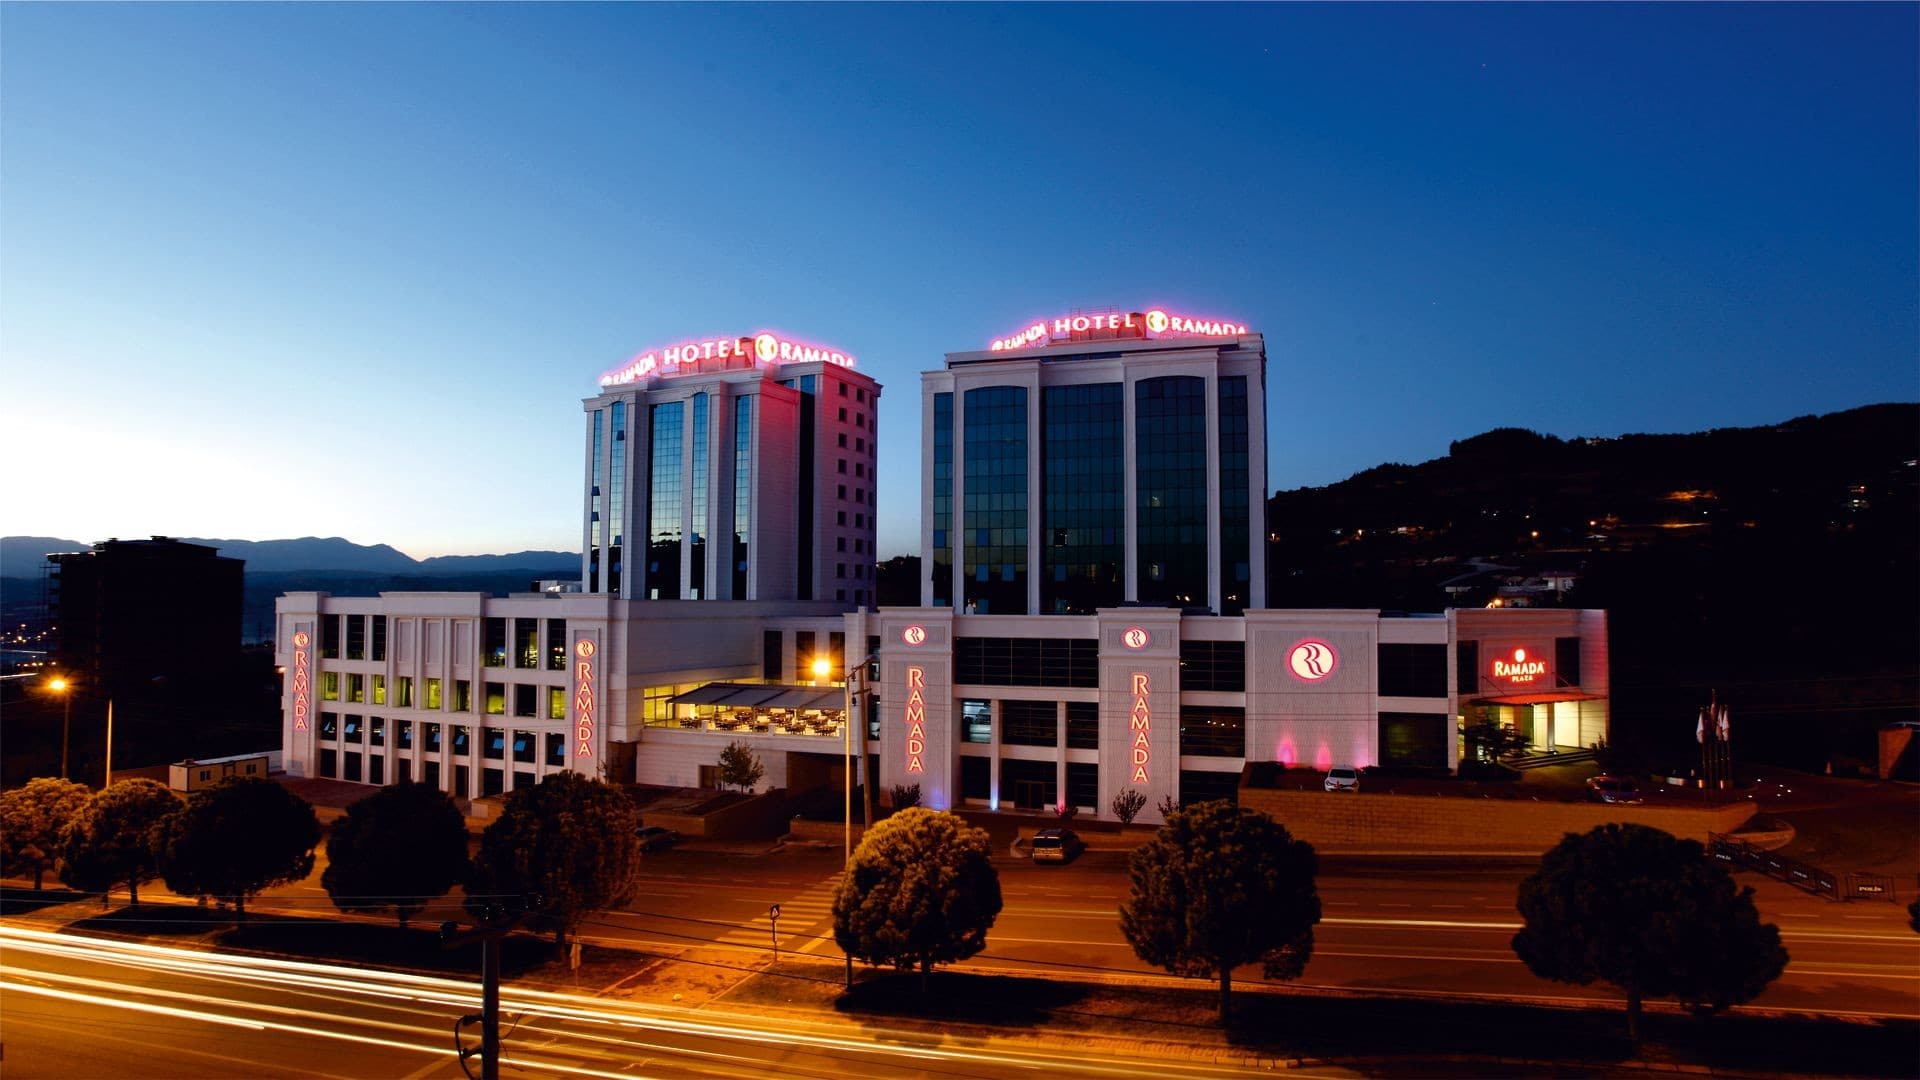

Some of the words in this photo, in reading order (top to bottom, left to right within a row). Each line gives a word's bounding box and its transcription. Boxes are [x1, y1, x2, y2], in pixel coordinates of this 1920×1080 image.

[1054, 313, 1136, 333] HOTEL
[1171, 317, 1246, 335] RAMADA
[663, 338, 745, 365] HOTEL
[781, 341, 854, 368] RAMADA
[293, 650, 308, 730] RAMADA
[1494, 660, 1544, 677] RAMADA
[1511, 674, 1534, 682] PLAZA
[576, 662, 594, 756] RAMADA
[906, 668, 925, 772] RAMADA
[1131, 675, 1150, 782] RAMADA
